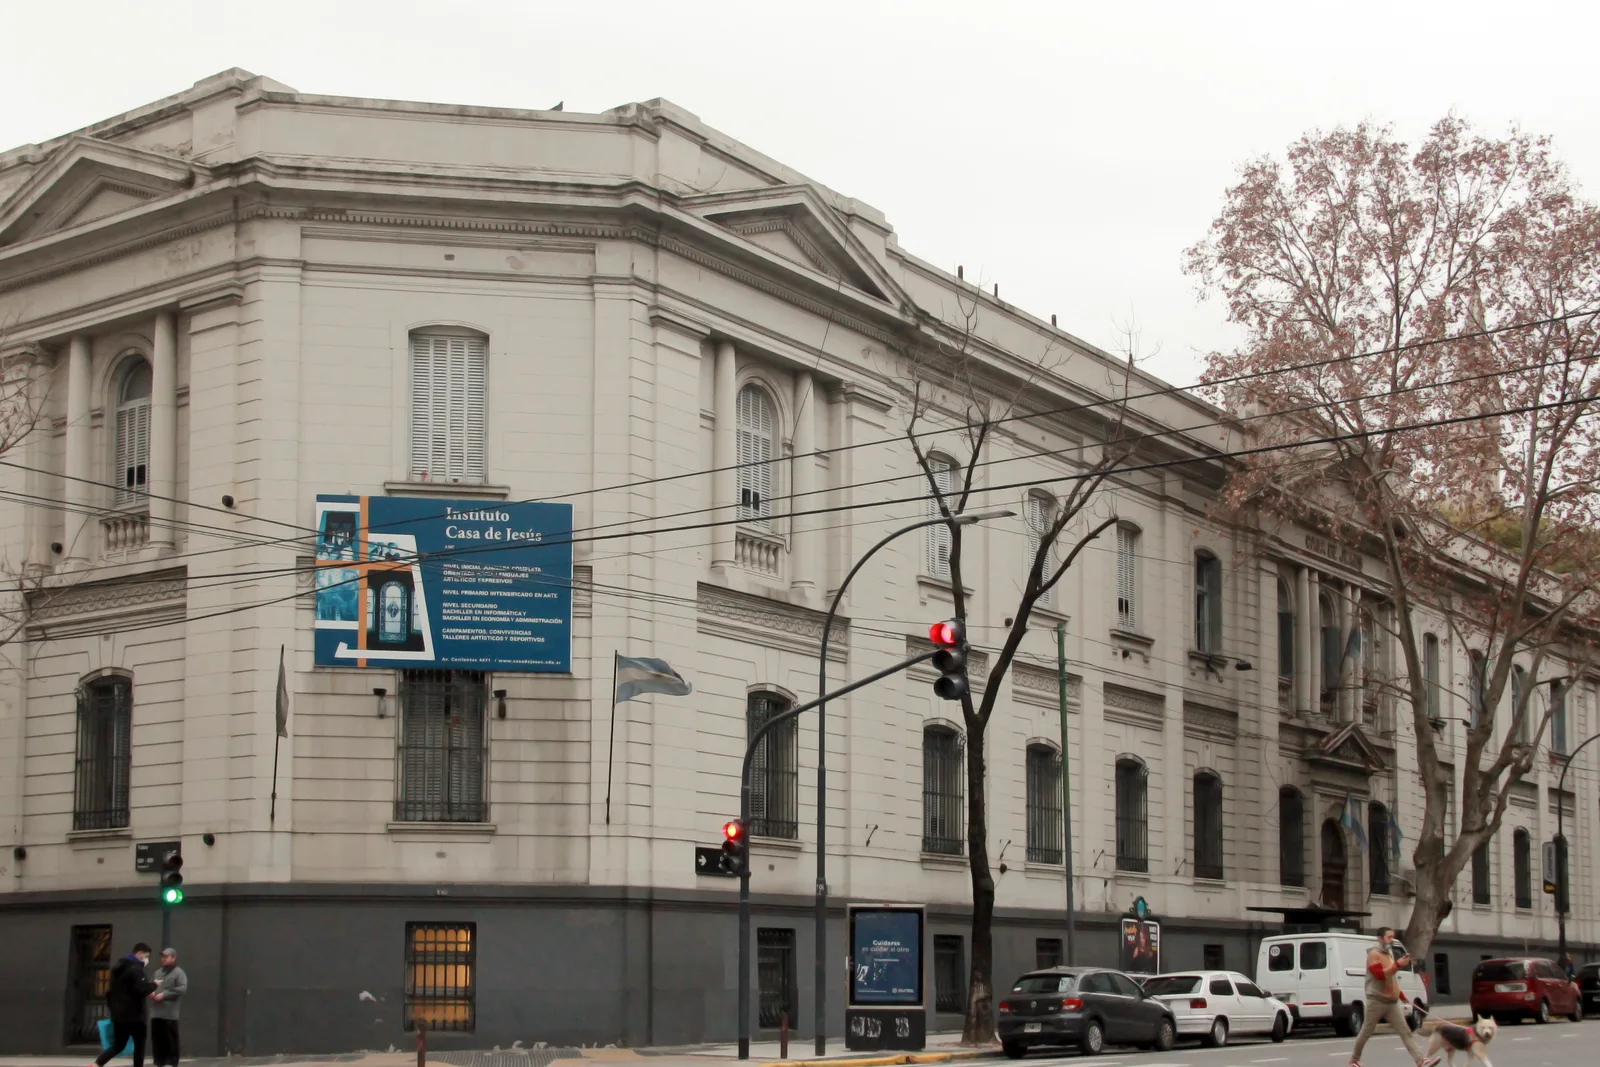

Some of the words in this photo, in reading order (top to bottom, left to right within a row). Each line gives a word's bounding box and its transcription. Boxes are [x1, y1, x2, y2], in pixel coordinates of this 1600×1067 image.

[446, 507, 510, 522] Instituto
[446, 525, 480, 539] Casa
[485, 527, 502, 540] de
[506, 528, 542, 542] Jesús
